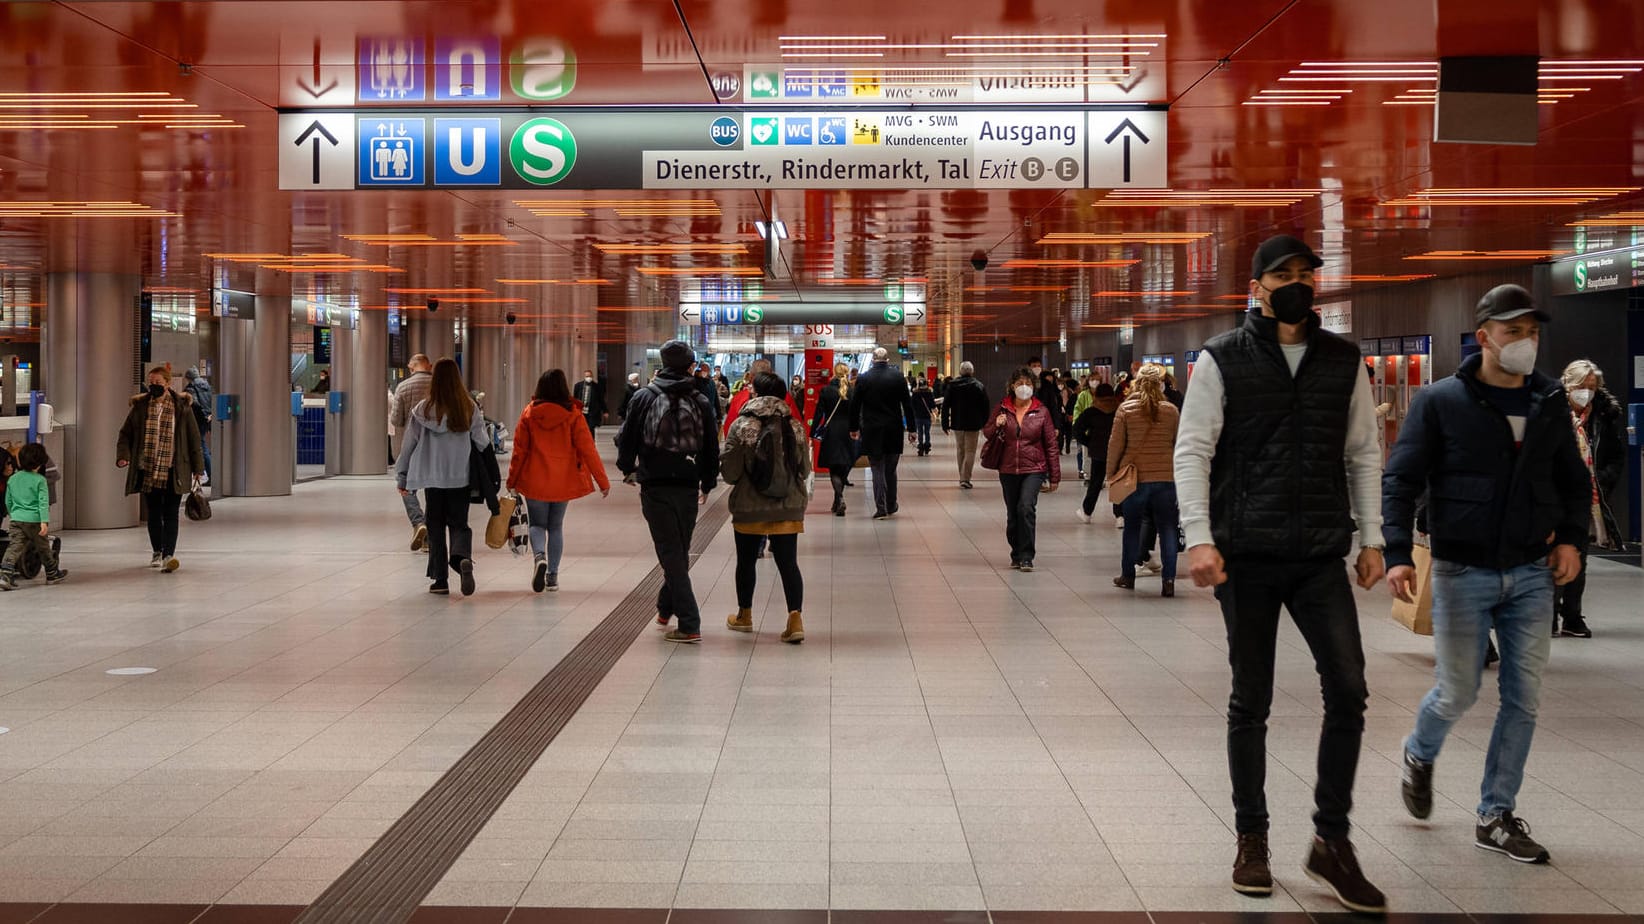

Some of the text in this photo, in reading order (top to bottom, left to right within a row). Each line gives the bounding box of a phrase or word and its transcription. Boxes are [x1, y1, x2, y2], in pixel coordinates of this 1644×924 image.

[832, 119, 846, 127] WC
[885, 115, 913, 127] MVG
[929, 115, 958, 127] SWM
[712, 125, 738, 137] BUS
[787, 125, 810, 138] WC
[979, 120, 1076, 145] Ausgang
[885, 134, 968, 146] Kundencenter
[449, 127, 487, 175] U
[522, 124, 566, 179] S
[656, 158, 969, 183] Dienerstr., Rindermarkt, Tal
[980, 159, 1017, 180] Exit
[1576, 264, 1585, 289] S
[726, 307, 739, 321] U
[746, 307, 760, 322] S
[887, 307, 901, 322] S
[806, 324, 833, 336] SOS
